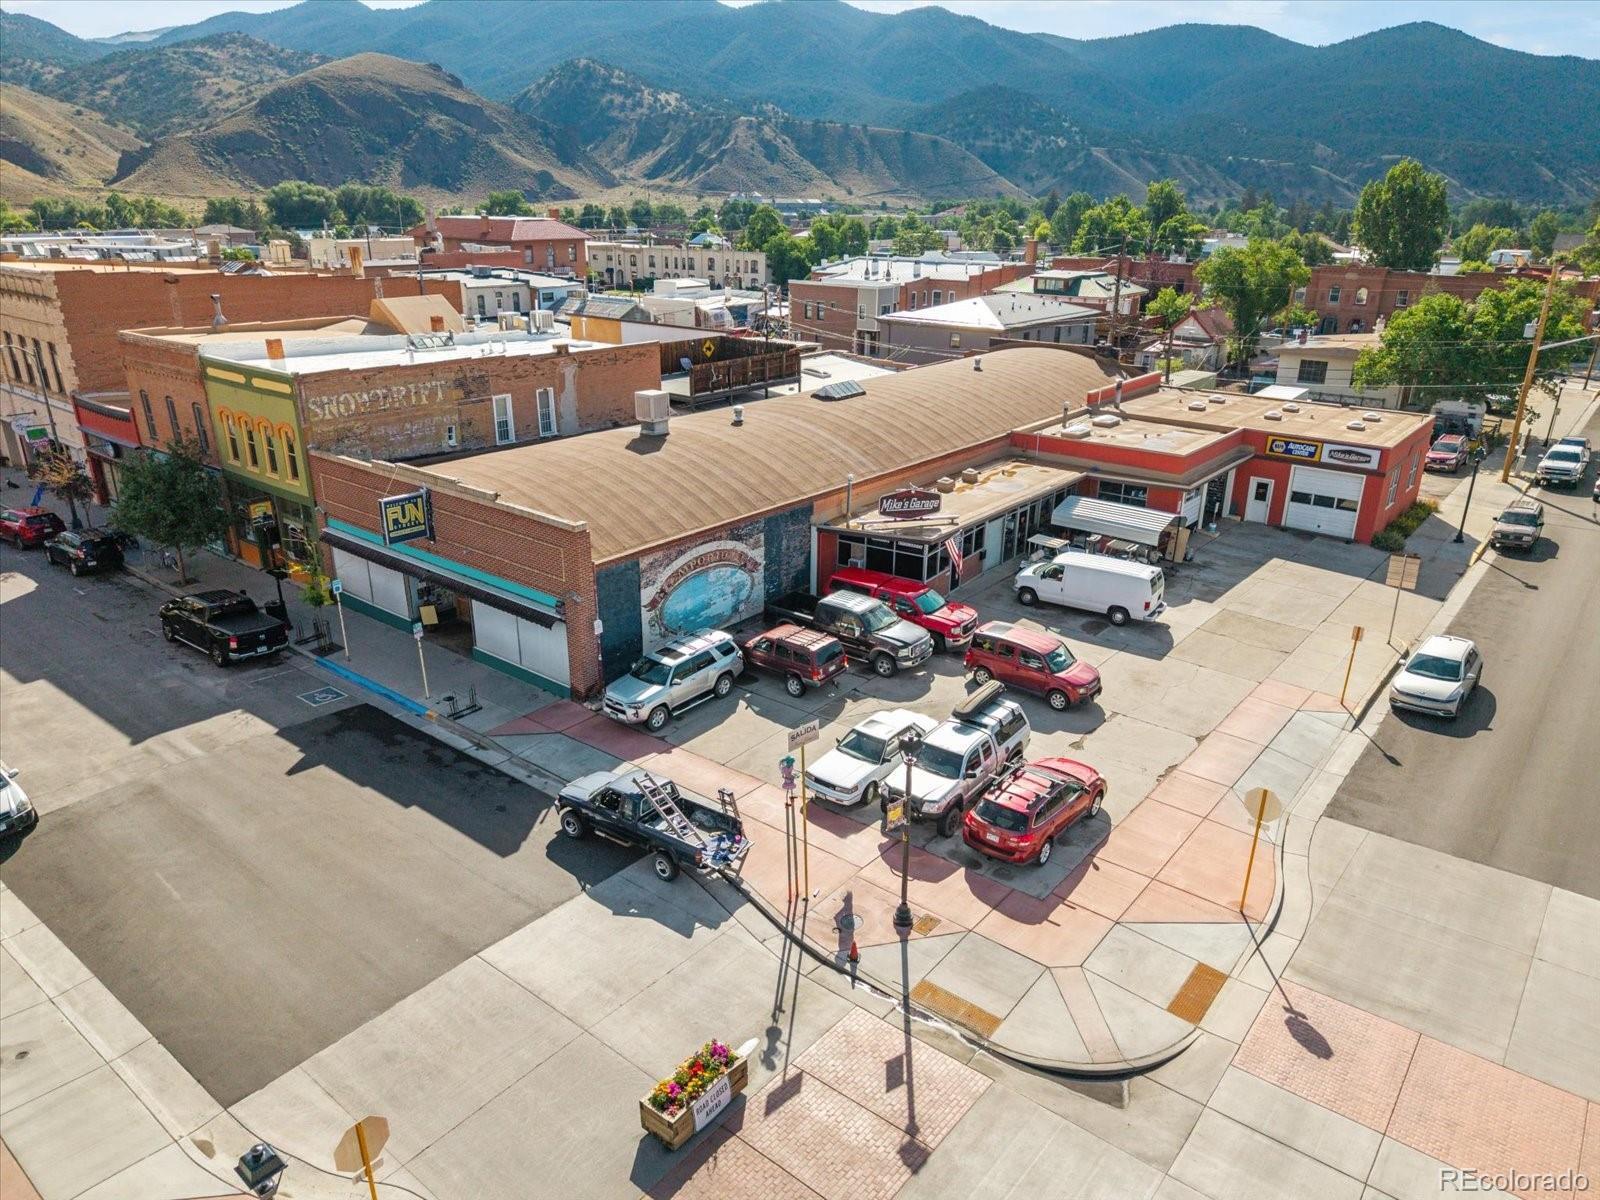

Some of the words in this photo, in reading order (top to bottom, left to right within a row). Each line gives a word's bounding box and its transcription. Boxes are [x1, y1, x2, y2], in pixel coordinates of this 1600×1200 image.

[386, 497, 425, 531] FUN
[880, 498, 909, 512] Mike's
[909, 497, 940, 509] Garage
[790, 725, 817, 741] SALIDA
[696, 1099, 710, 1116] ROAD
[710, 1082, 729, 1103] CLOSED
[705, 1099, 722, 1118] AHEAD
